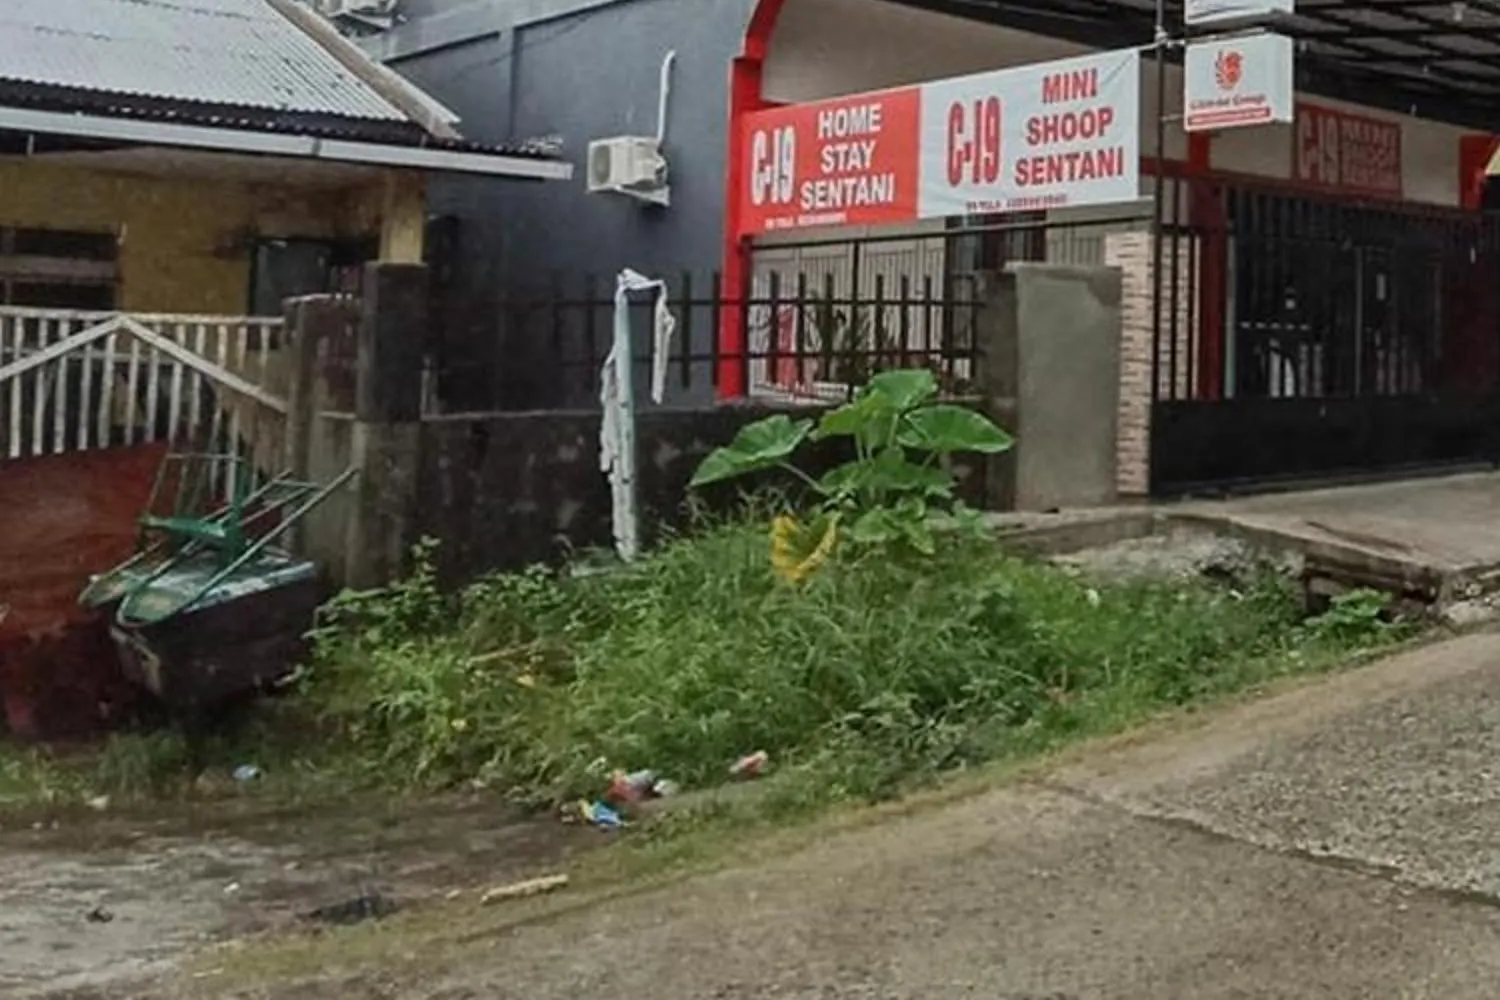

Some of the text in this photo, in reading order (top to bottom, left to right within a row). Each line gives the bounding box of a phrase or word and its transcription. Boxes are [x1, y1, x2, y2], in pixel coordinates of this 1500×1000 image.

[1042, 68, 1098, 104] MINI
[817, 102, 882, 139] HOME
[1026, 106, 1114, 145] SHOOP
[820, 139, 876, 174] STAY
[947, 96, 1001, 187] C-19
[752, 125, 795, 206] C-19
[1015, 146, 1123, 187] SENTANI
[800, 172, 894, 210] SENTANI
